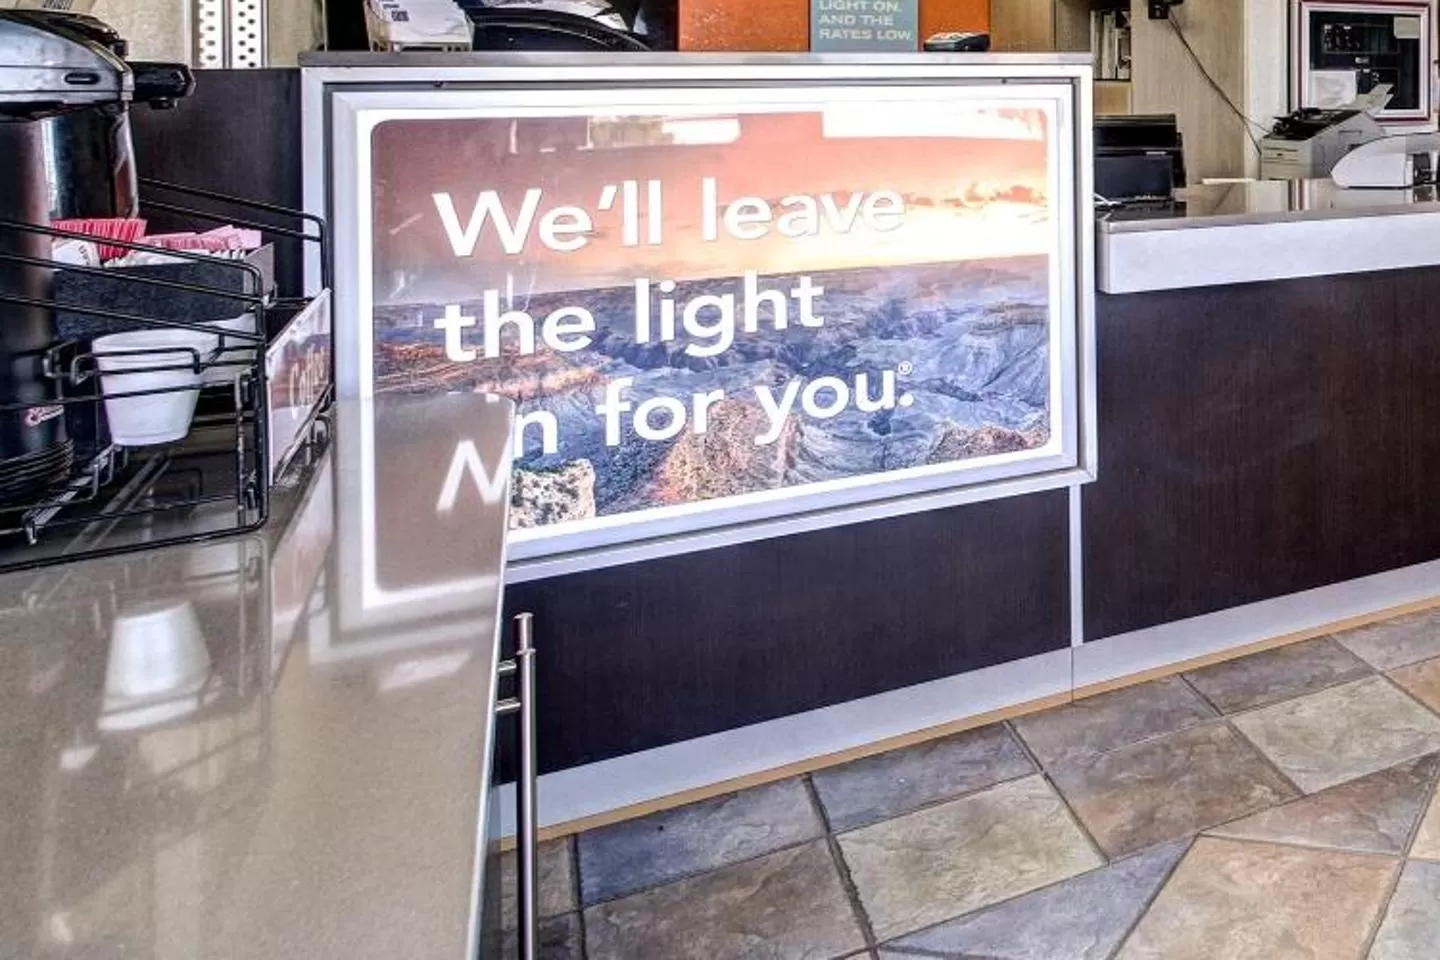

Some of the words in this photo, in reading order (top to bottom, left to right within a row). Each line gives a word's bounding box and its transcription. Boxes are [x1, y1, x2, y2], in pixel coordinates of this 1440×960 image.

[819, 13, 857, 25] AND
[860, 14, 894, 26] THE
[819, 28, 873, 39] RATES
[433, 177, 663, 257] We'll
[703, 177, 906, 242] leave
[435, 288, 595, 363] the
[635, 269, 825, 357] light
[596, 376, 725, 446] for
